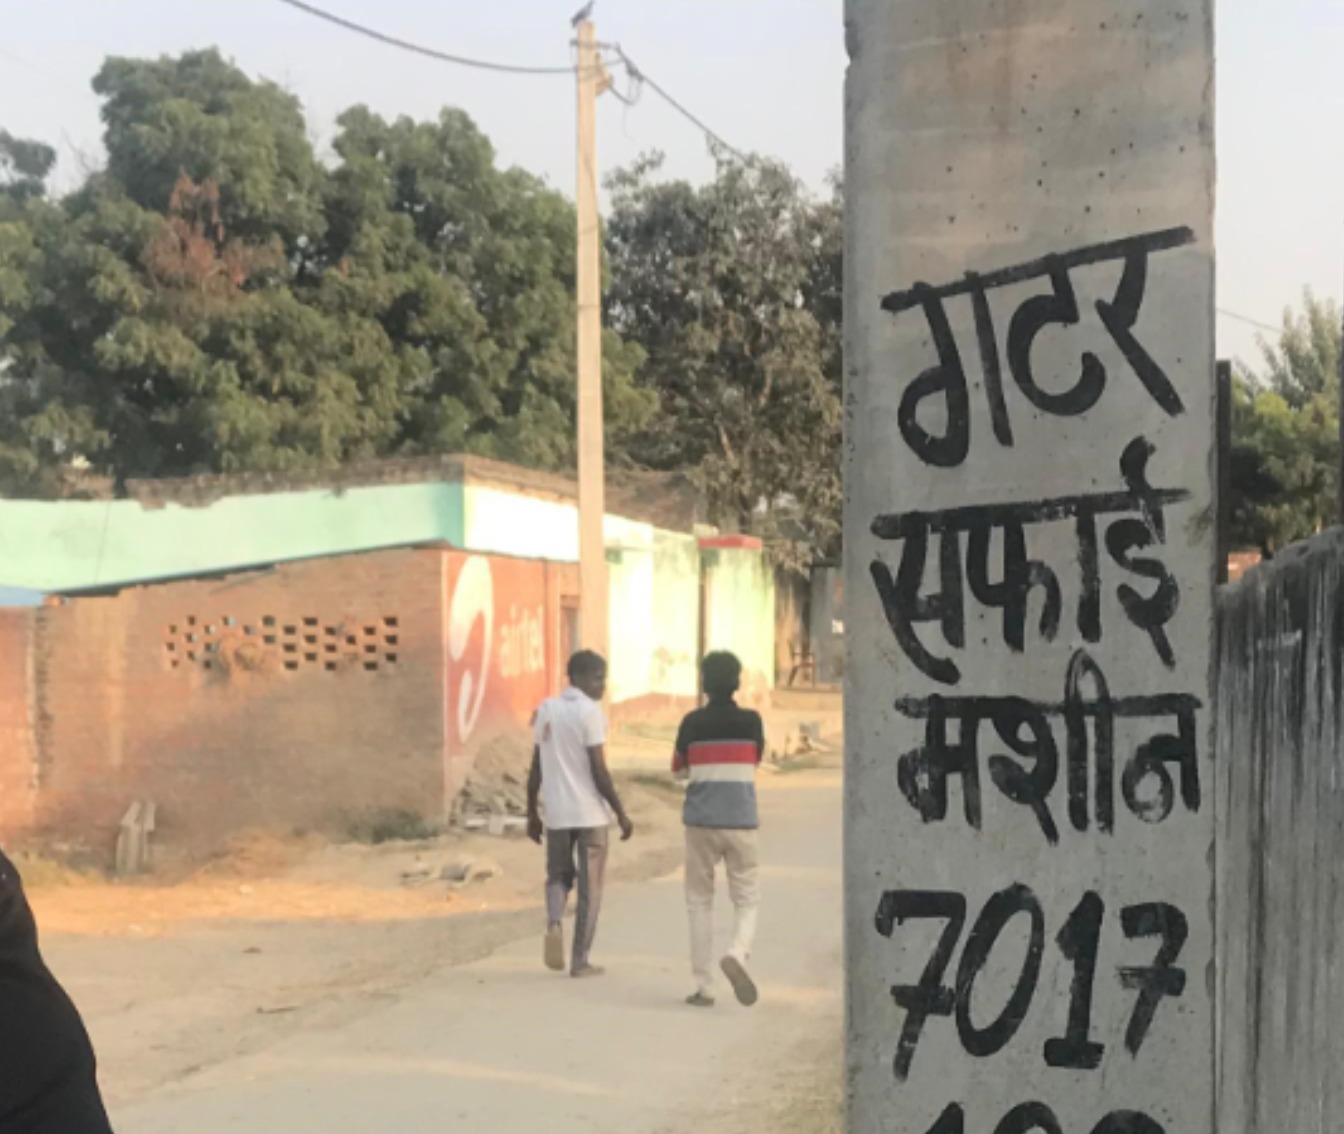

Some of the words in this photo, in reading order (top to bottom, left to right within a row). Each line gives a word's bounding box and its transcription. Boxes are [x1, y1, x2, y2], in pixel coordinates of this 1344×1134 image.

[881, 226, 1197, 467] गटर
[870, 436, 1191, 685] सफाई
[895, 648, 1203, 846] मशीन
[874, 882, 1189, 1082] 7017
